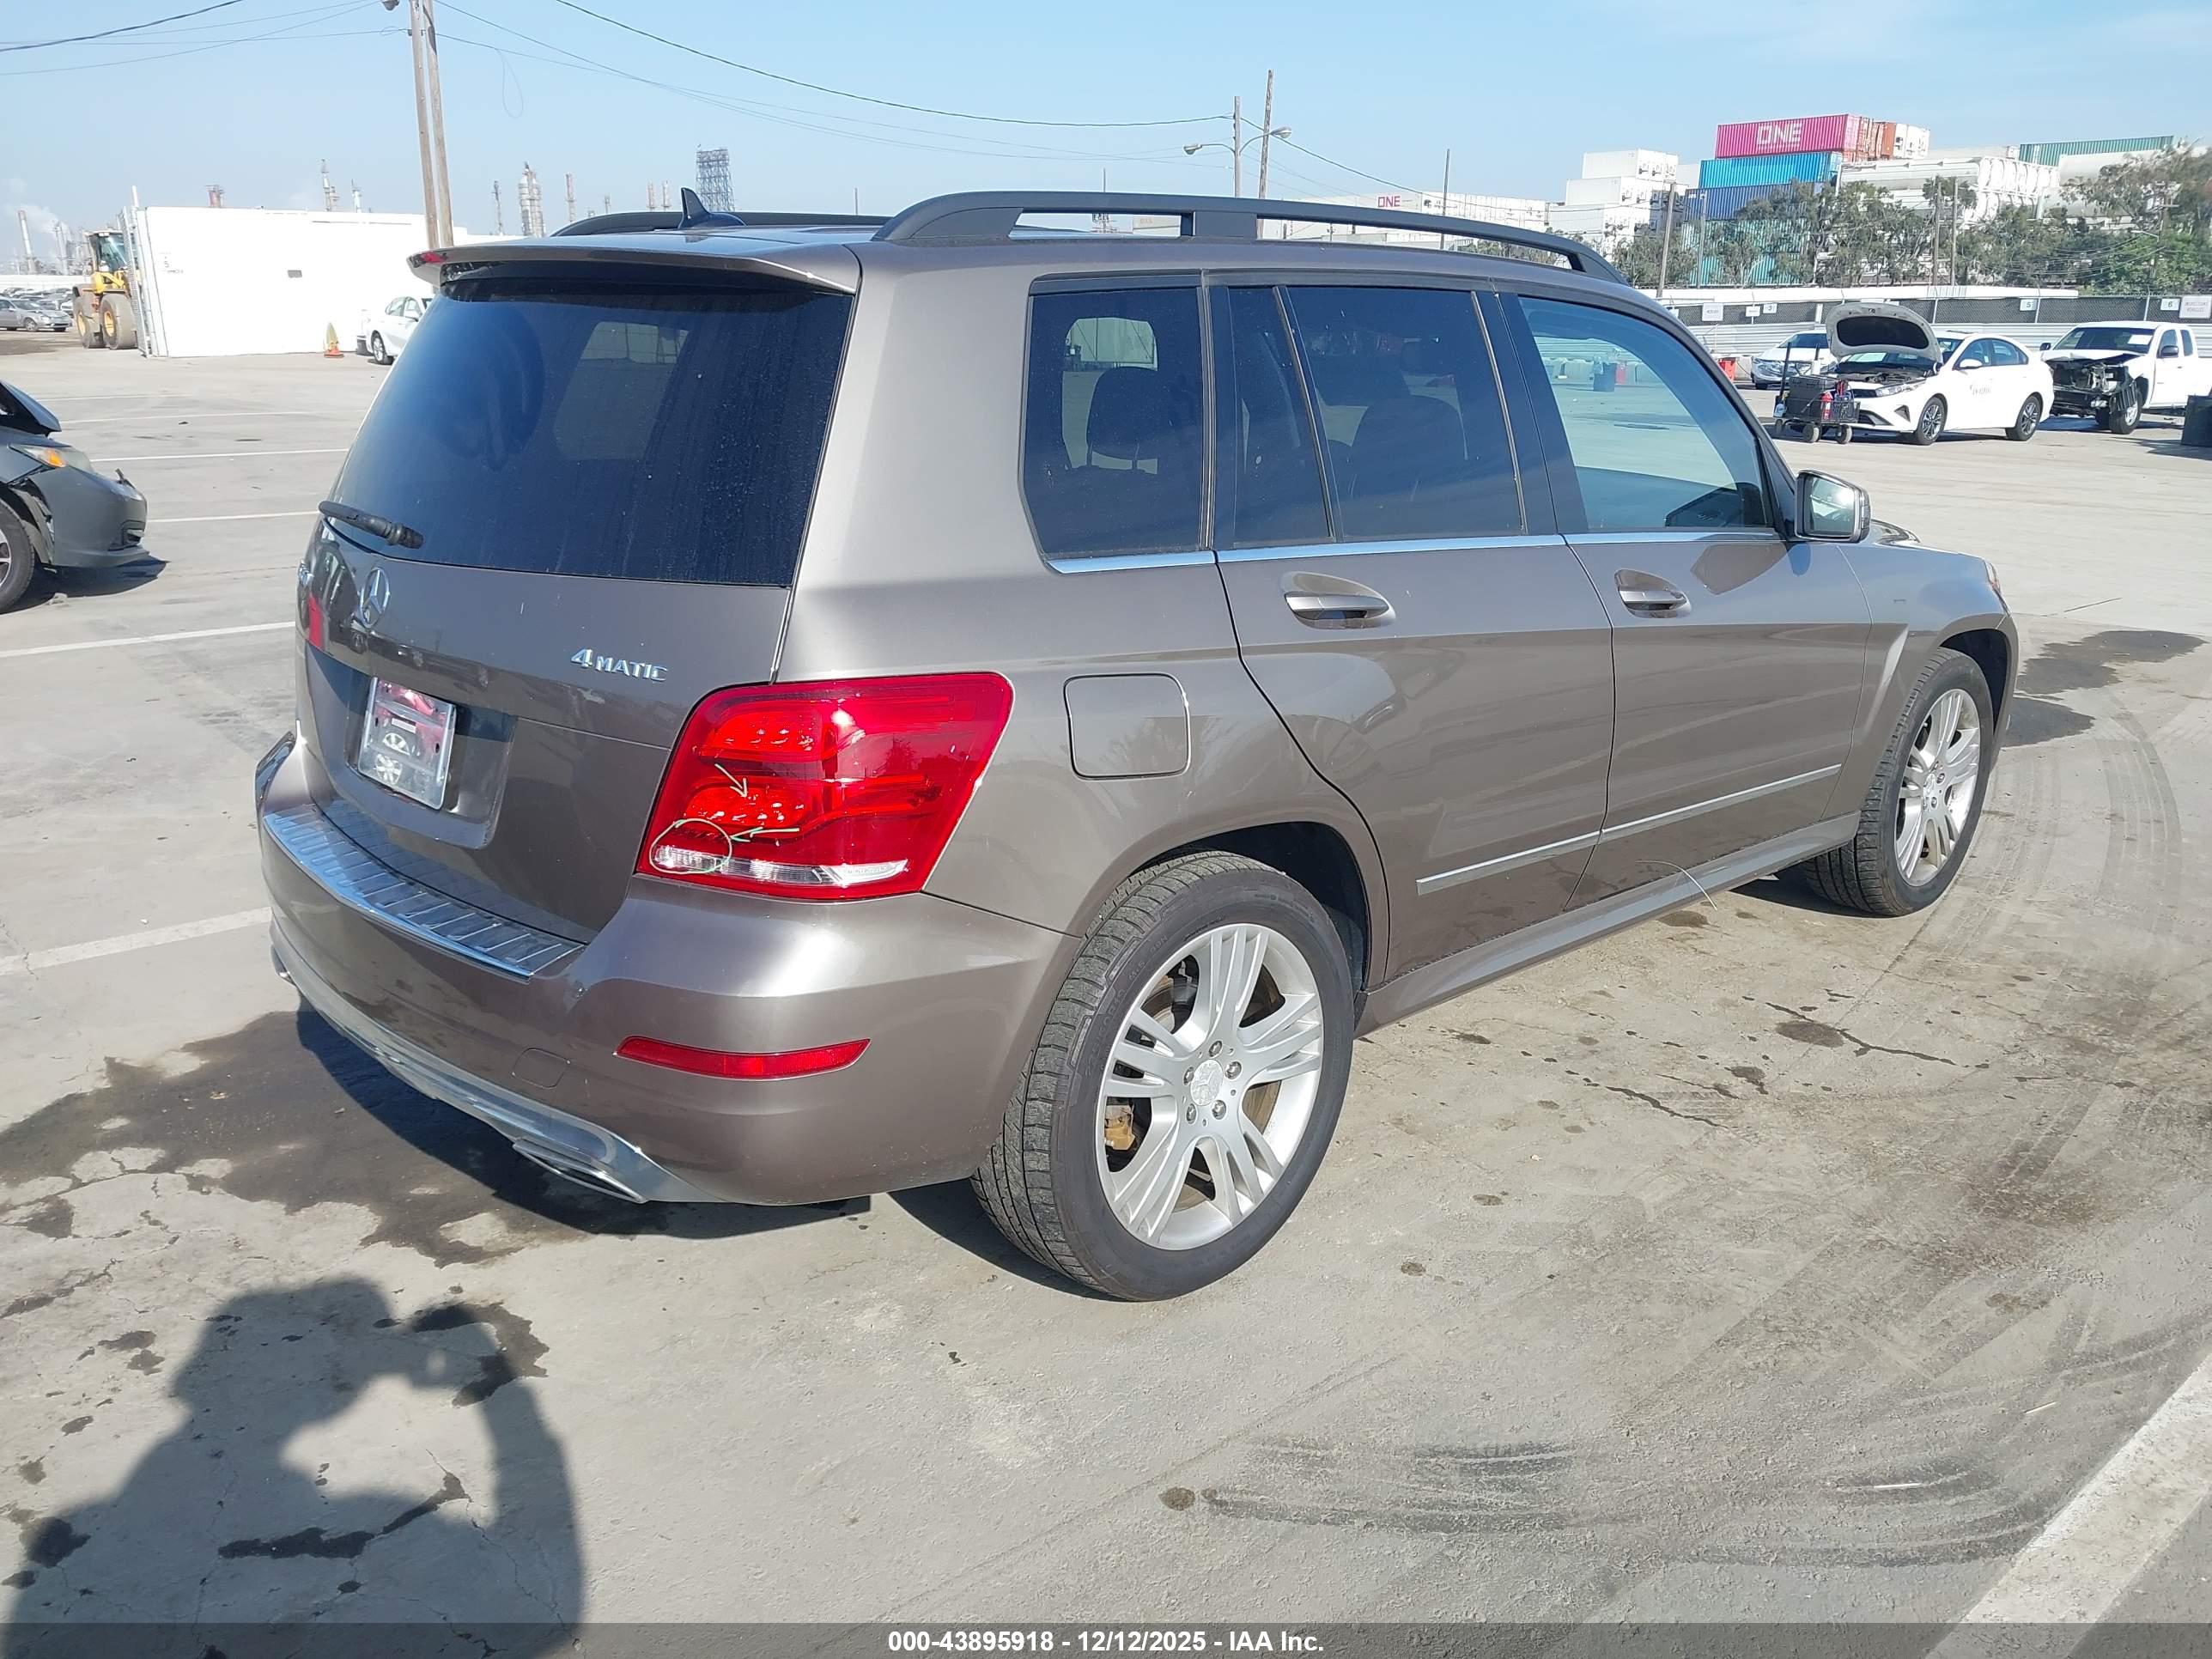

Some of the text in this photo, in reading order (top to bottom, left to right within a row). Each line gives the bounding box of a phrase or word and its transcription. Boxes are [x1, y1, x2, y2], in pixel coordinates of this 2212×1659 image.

[1756, 123, 1802, 145] ONE
[1377, 196, 1401, 208] ONE
[570, 648, 668, 683] 4MATIC
